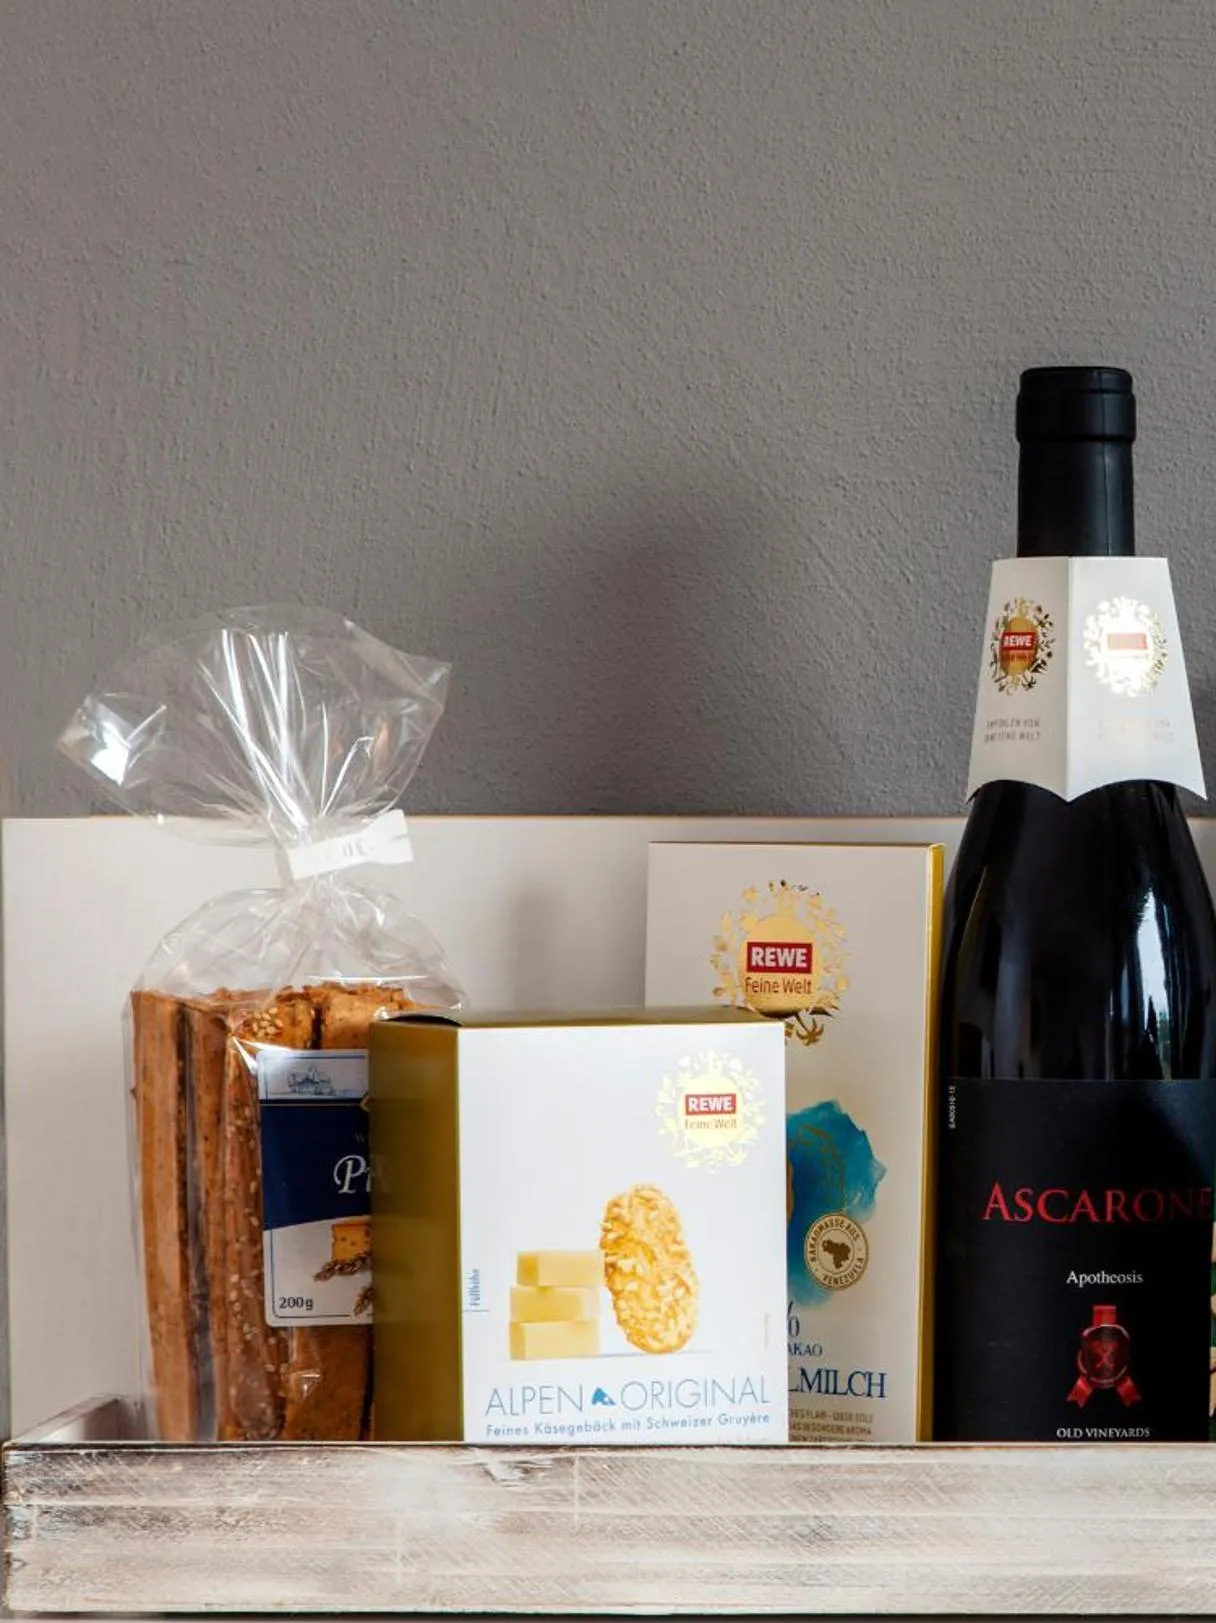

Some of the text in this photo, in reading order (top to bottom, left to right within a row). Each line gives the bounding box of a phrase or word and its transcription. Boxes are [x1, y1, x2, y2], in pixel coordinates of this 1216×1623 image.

[1003, 634, 1033, 648] REWE
[751, 946, 808, 968] REWE
[745, 976, 812, 995] Feine Welt
[688, 1096, 733, 1112] REWE
[685, 1117, 737, 1130] Feine Welt
[1066, 1269, 1144, 1288] Apotheosis
[485, 1375, 771, 1417] ALPEN ORIGINAL
[486, 1423, 530, 1438] Feines
[534, 1420, 616, 1437] Käsegebäck
[621, 1417, 641, 1432] mit
[647, 1413, 713, 1431] Schweizer
[717, 1412, 771, 1430] Gruyère
[1056, 1426, 1151, 1440] OLD VINEYARDS
